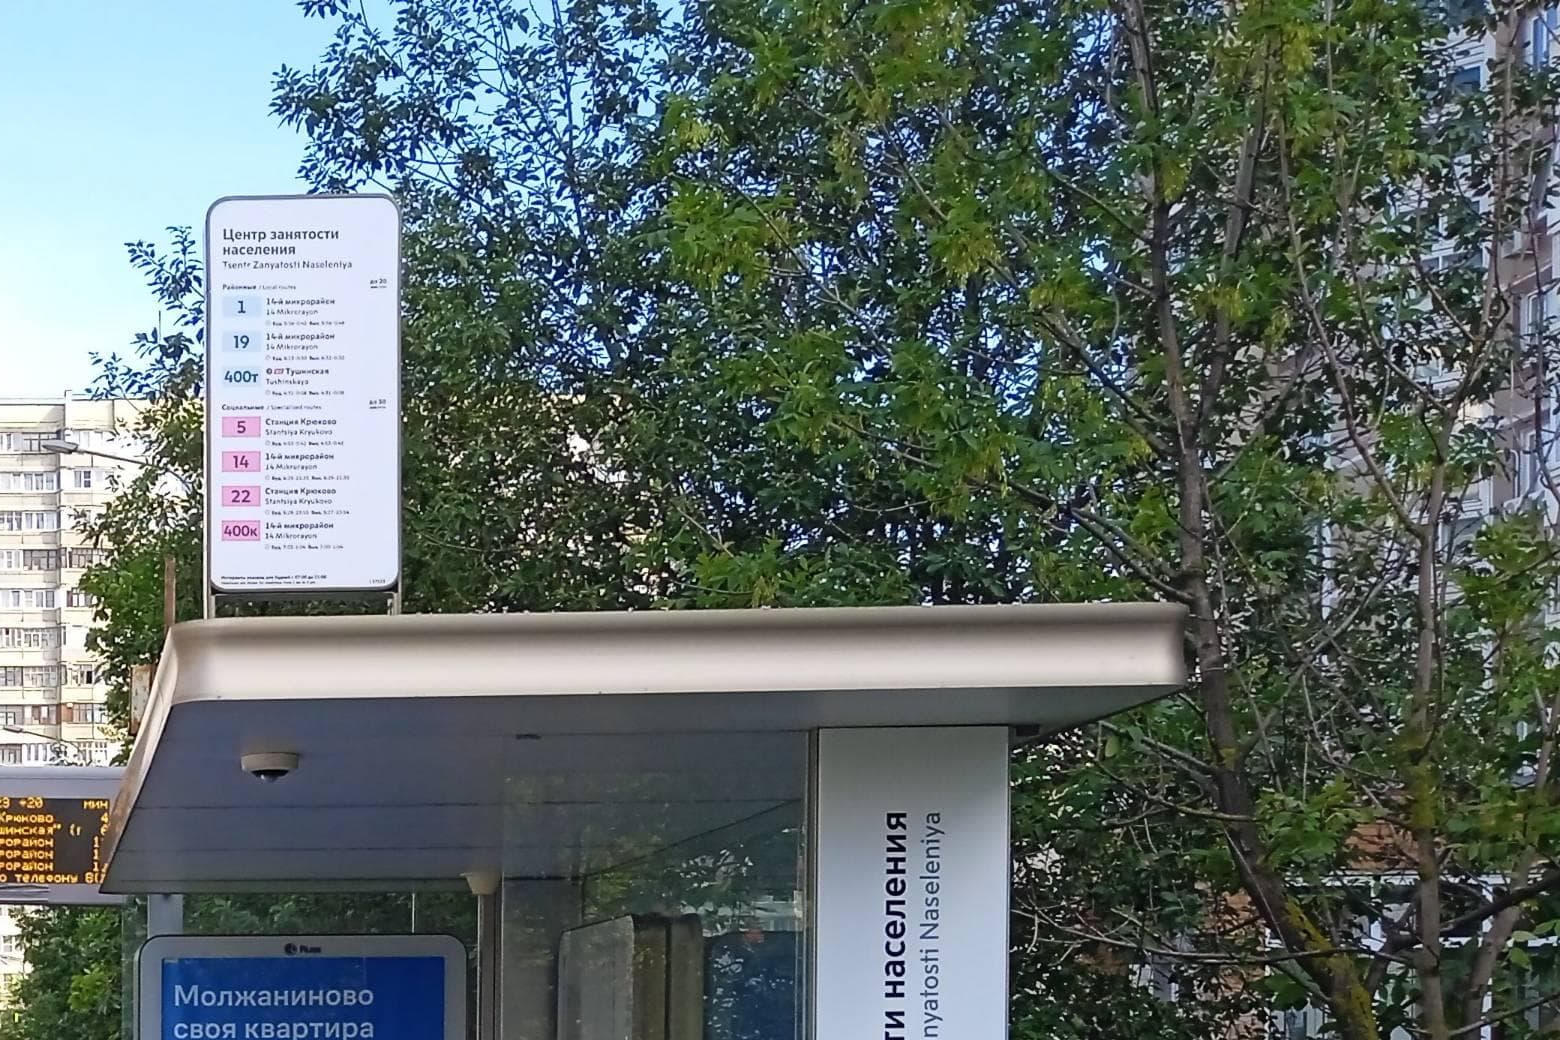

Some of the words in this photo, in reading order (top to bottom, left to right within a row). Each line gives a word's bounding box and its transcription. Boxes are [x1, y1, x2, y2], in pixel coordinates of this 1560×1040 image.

[223, 228, 266, 242] Центр
[270, 230, 339, 240] занятости
[223, 245, 296, 255] населения
[223, 261, 251, 269] Tsentr
[252, 260, 300, 271] Zanyatosti
[302, 261, 352, 270] Naseleniya
[238, 300, 246, 314] 1
[234, 336, 250, 349] 19
[224, 370, 259, 383] 400т
[286, 368, 330, 376] Тушинская
[237, 420, 246, 434] 5
[265, 418, 298, 426] Станция
[300, 418, 336, 426] Крюково
[232, 455, 250, 468] 14
[232, 490, 250, 503] 22
[265, 488, 298, 496] Станция
[300, 488, 336, 496] Крюково
[224, 524, 258, 537] 400к
[84, 800, 108, 810] мин
[100, 812, 108, 824] 4
[15, 873, 78, 884] телефону
[920, 812, 946, 940] Naseleniya
[884, 810, 908, 999] населения
[174, 984, 374, 1007] Молжаниново
[174, 1022, 236, 1039] своя
